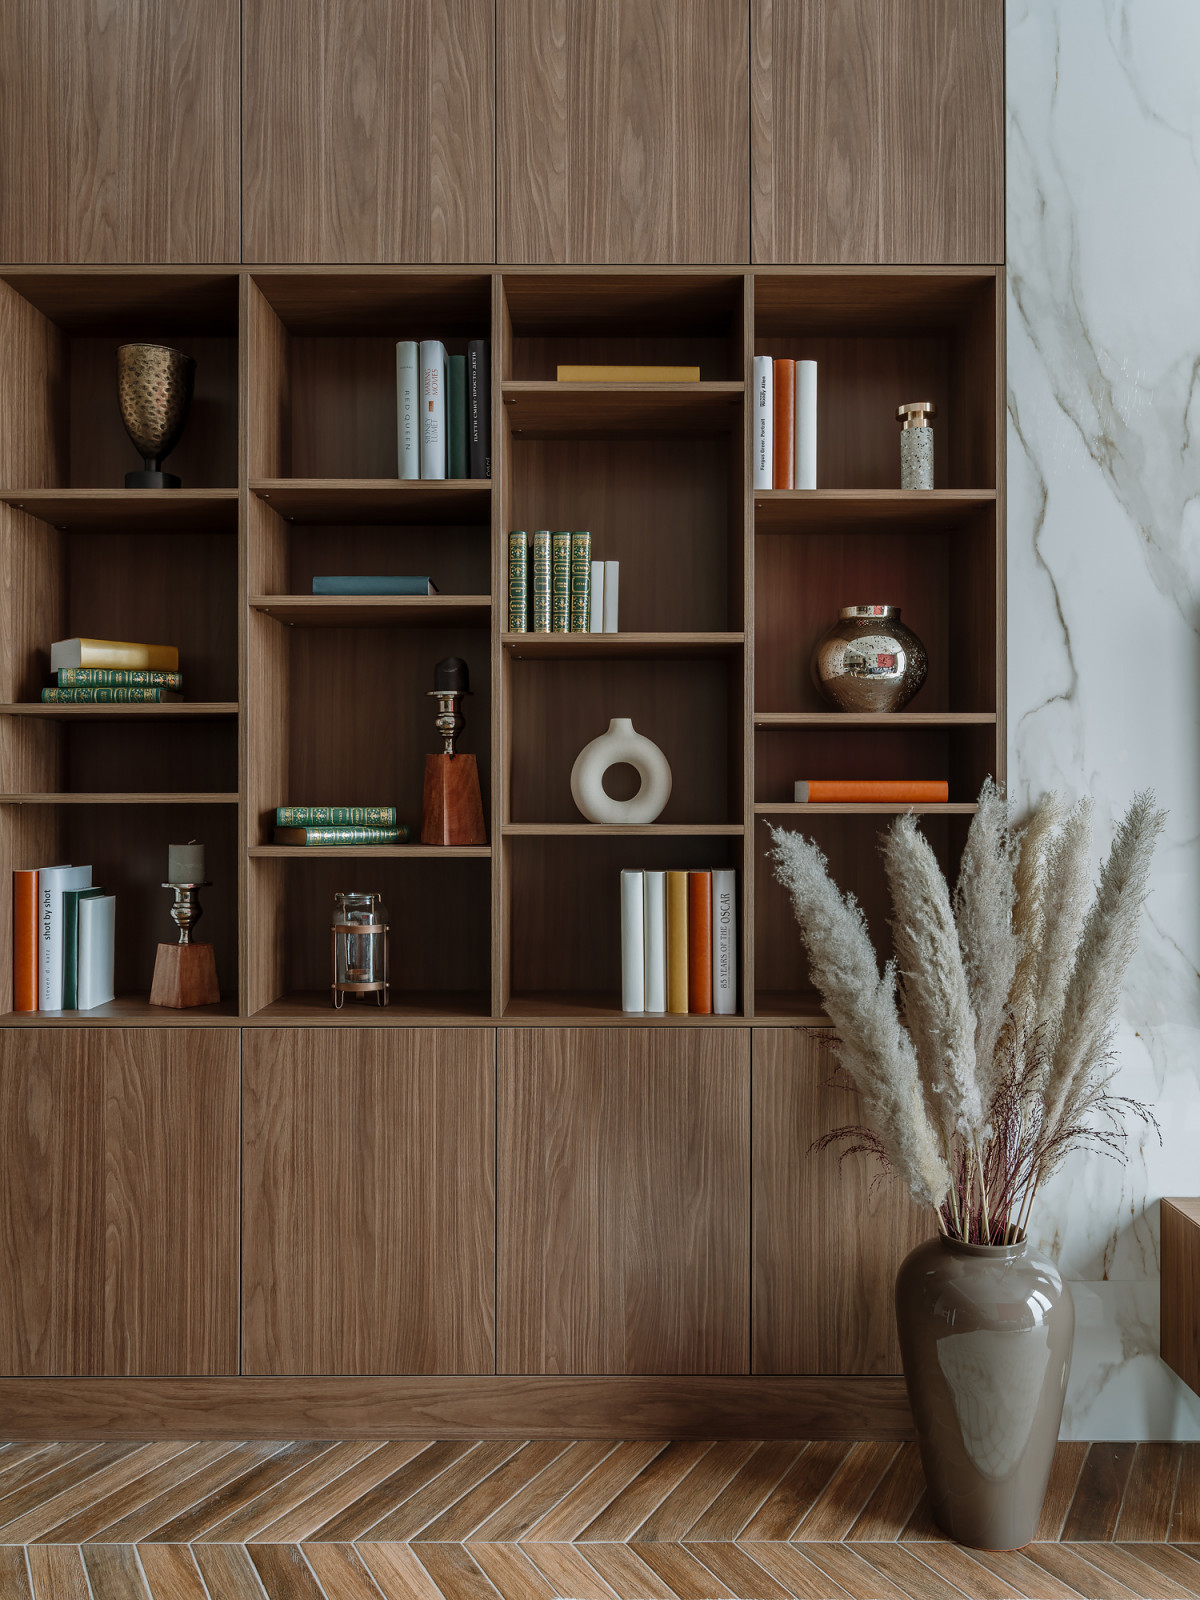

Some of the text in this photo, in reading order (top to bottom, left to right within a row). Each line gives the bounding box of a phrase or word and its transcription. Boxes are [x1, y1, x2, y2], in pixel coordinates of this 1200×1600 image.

[431, 368, 439, 396] MOVIES
[431, 419, 439, 443] LUMET
[43, 889, 52, 941] shot by shot
[720, 892, 731, 989] 85 YEARS OF THE OSCAR
